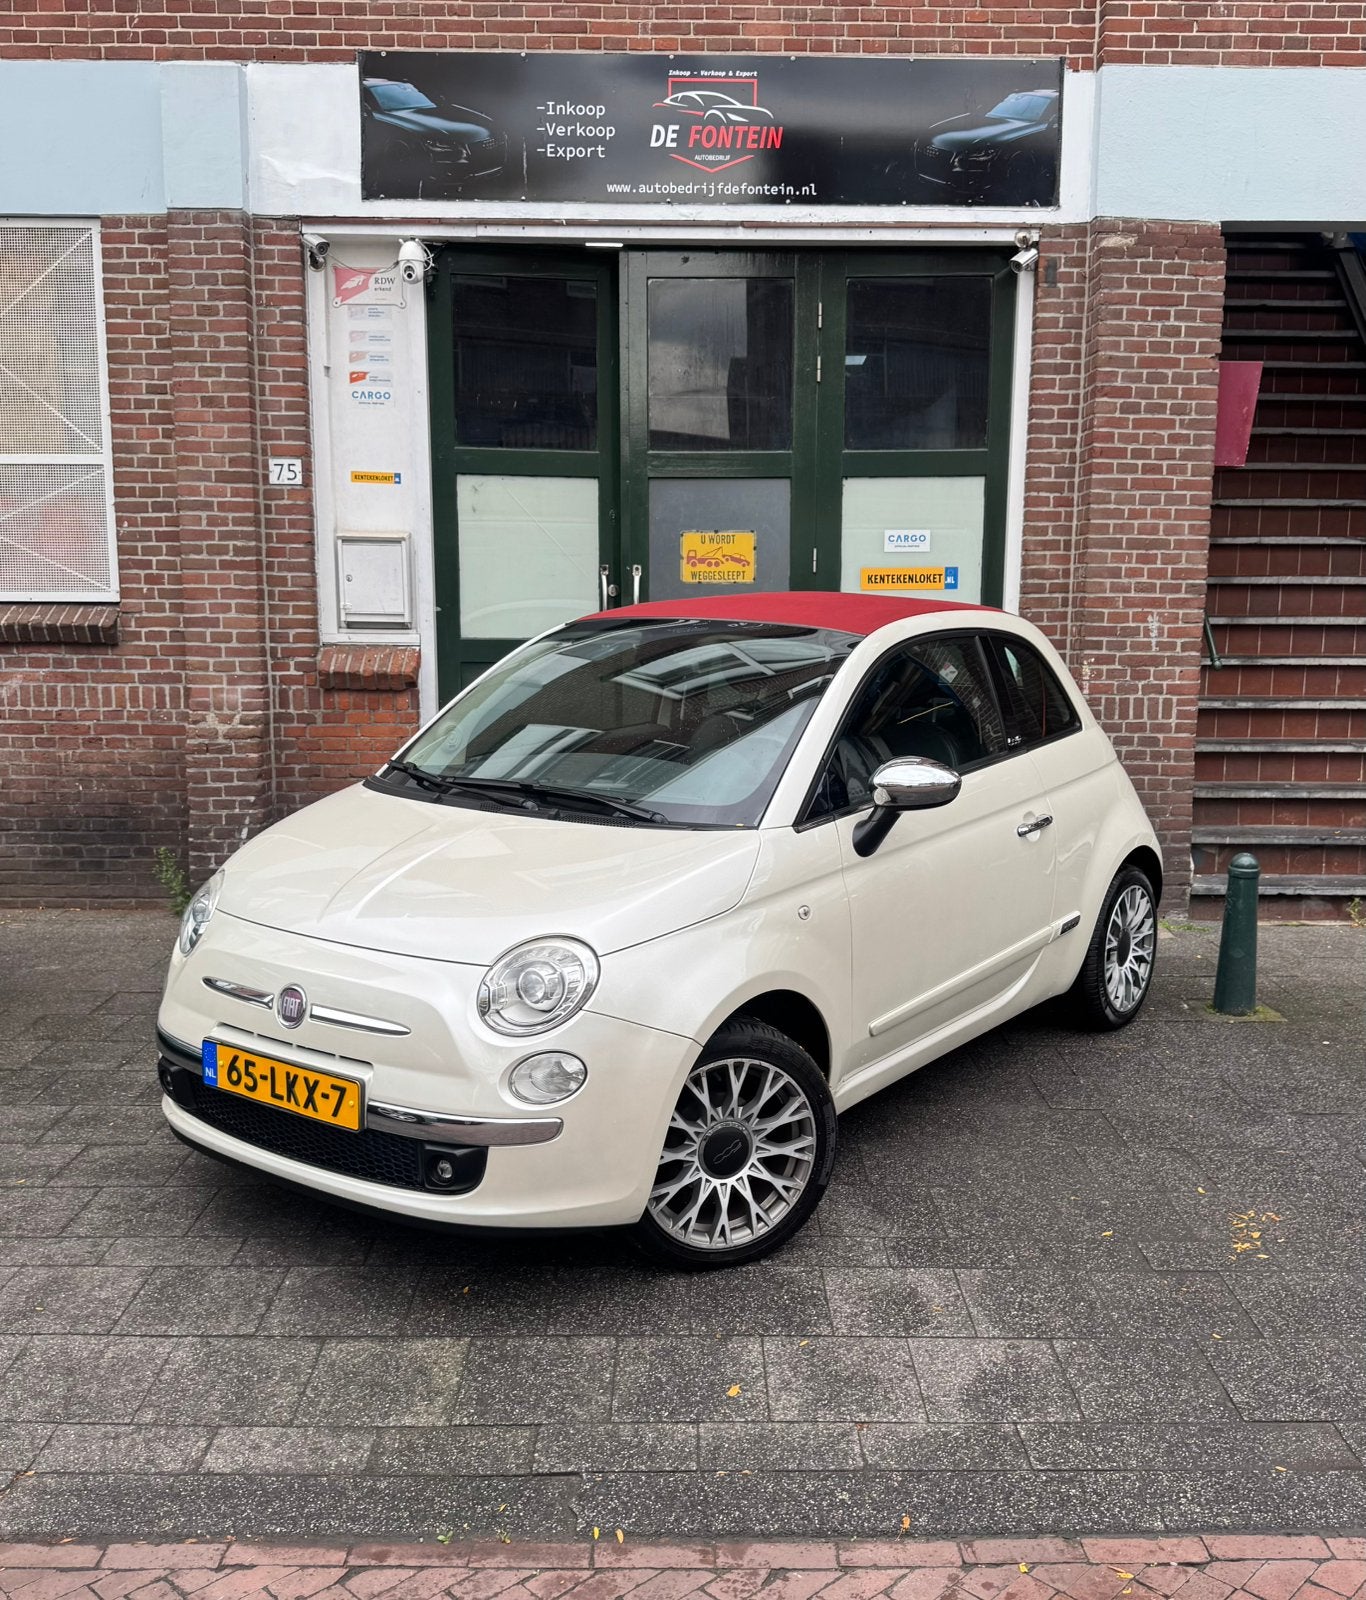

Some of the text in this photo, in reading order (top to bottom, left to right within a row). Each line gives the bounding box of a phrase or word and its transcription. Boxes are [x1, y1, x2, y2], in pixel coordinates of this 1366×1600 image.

[668, 69, 691, 77] Inkoop
[700, 69, 727, 77] Verkoop
[650, 124, 784, 149] DE FONTEIN
[606, 182, 818, 197] www.autobedrijfdefontein.nl
[374, 277, 396, 285] RDW
[351, 390, 392, 400] CARGO
[273, 463, 298, 481] 75
[701, 534, 736, 545] U WORDT
[887, 534, 927, 543] CARGO
[690, 570, 746, 581] WEGGESLEEPT
[282, 996, 301, 1018] FIAT
[205, 1054, 347, 1118] NL 65-LKX-7
